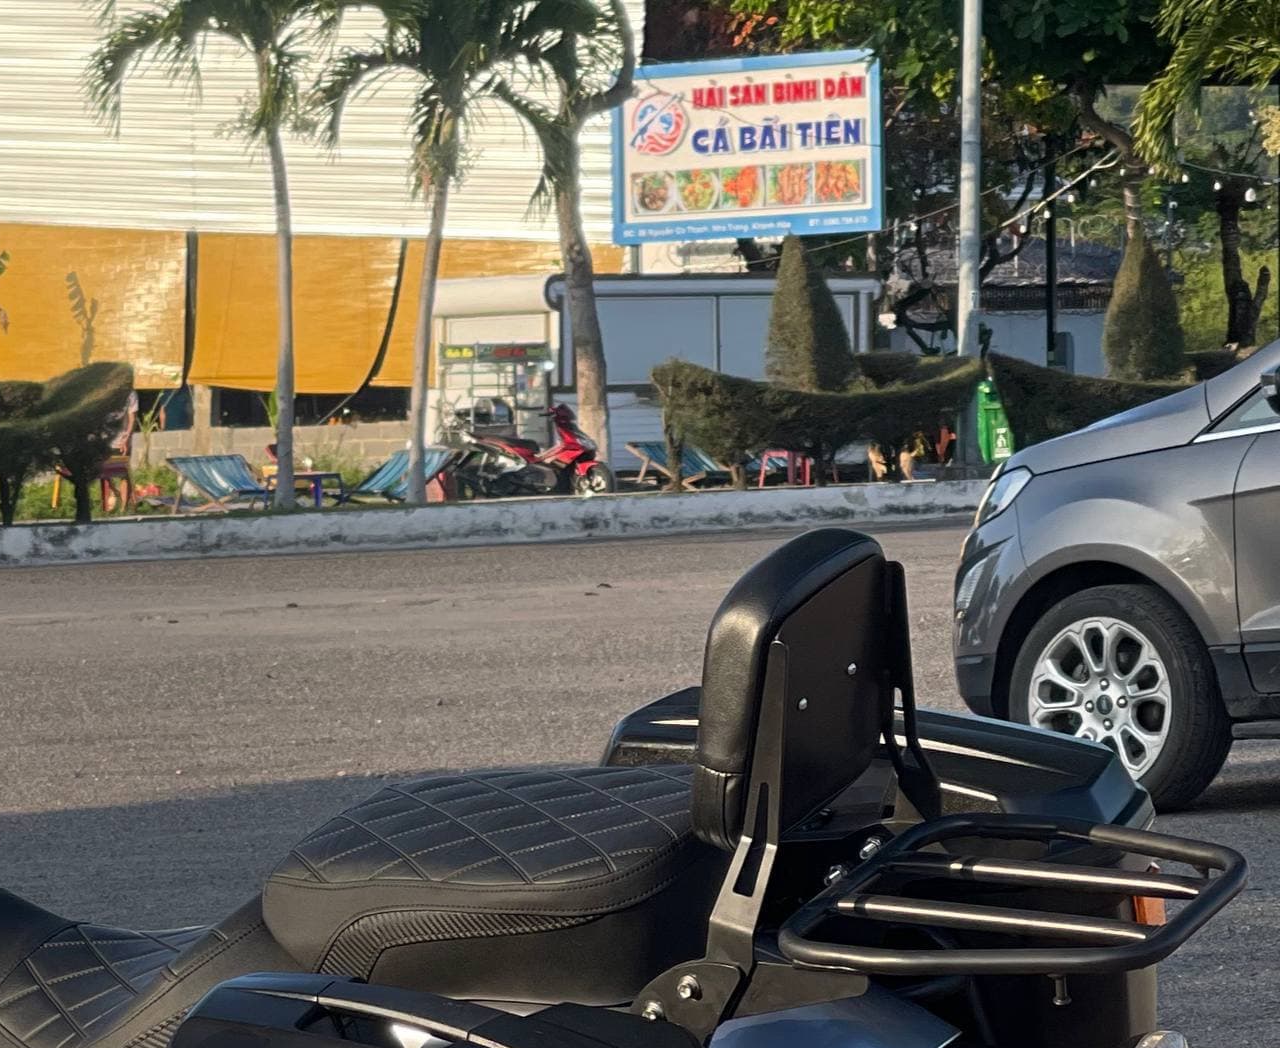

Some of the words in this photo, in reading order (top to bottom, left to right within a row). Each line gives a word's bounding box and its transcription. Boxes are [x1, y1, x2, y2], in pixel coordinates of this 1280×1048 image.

[692, 79, 725, 109] HẢI
[729, 76, 767, 107] SẢN
[772, 73, 818, 103] BÌNH
[823, 71, 866, 100] DÂN
[691, 116, 734, 155] CÁ
[738, 115, 790, 152] BÃI
